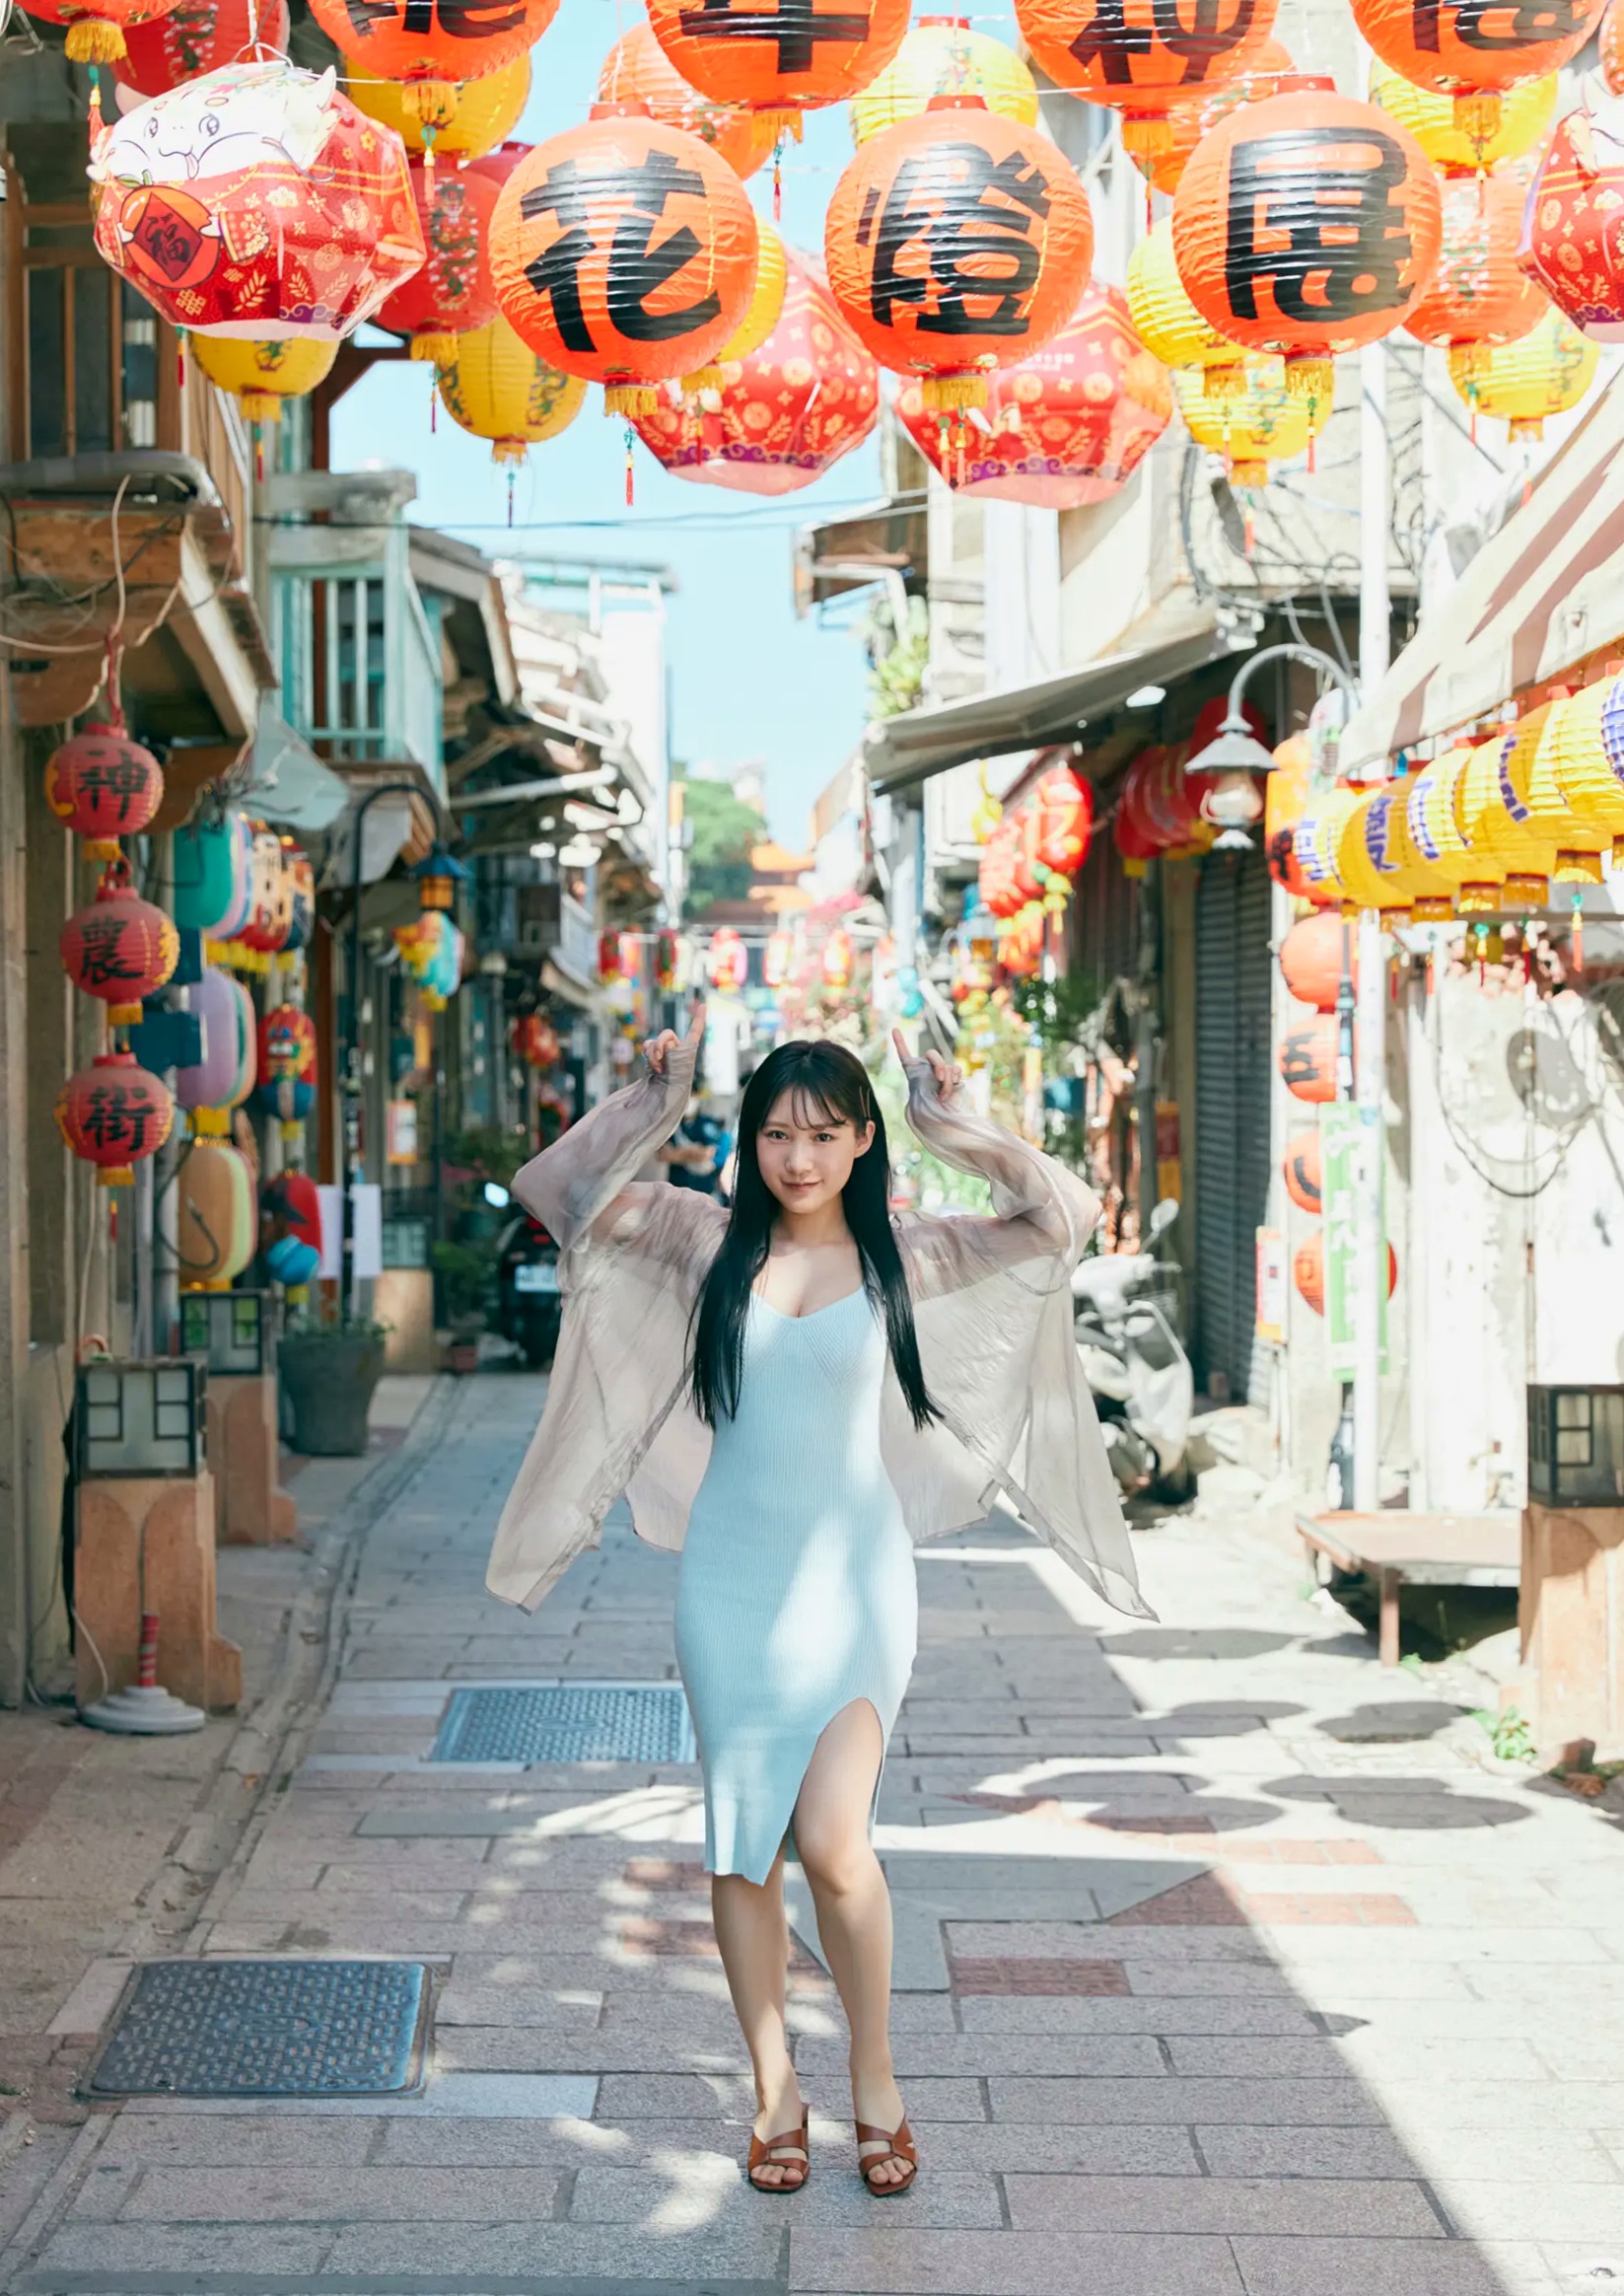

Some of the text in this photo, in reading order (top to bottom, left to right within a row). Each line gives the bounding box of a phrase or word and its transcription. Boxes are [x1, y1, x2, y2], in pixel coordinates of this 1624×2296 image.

[521, 149, 722, 353] 花
[1226, 127, 1416, 323] 展
[77, 749, 149, 820] 神
[80, 914, 145, 984] 農
[83, 1085, 155, 1151] 街
